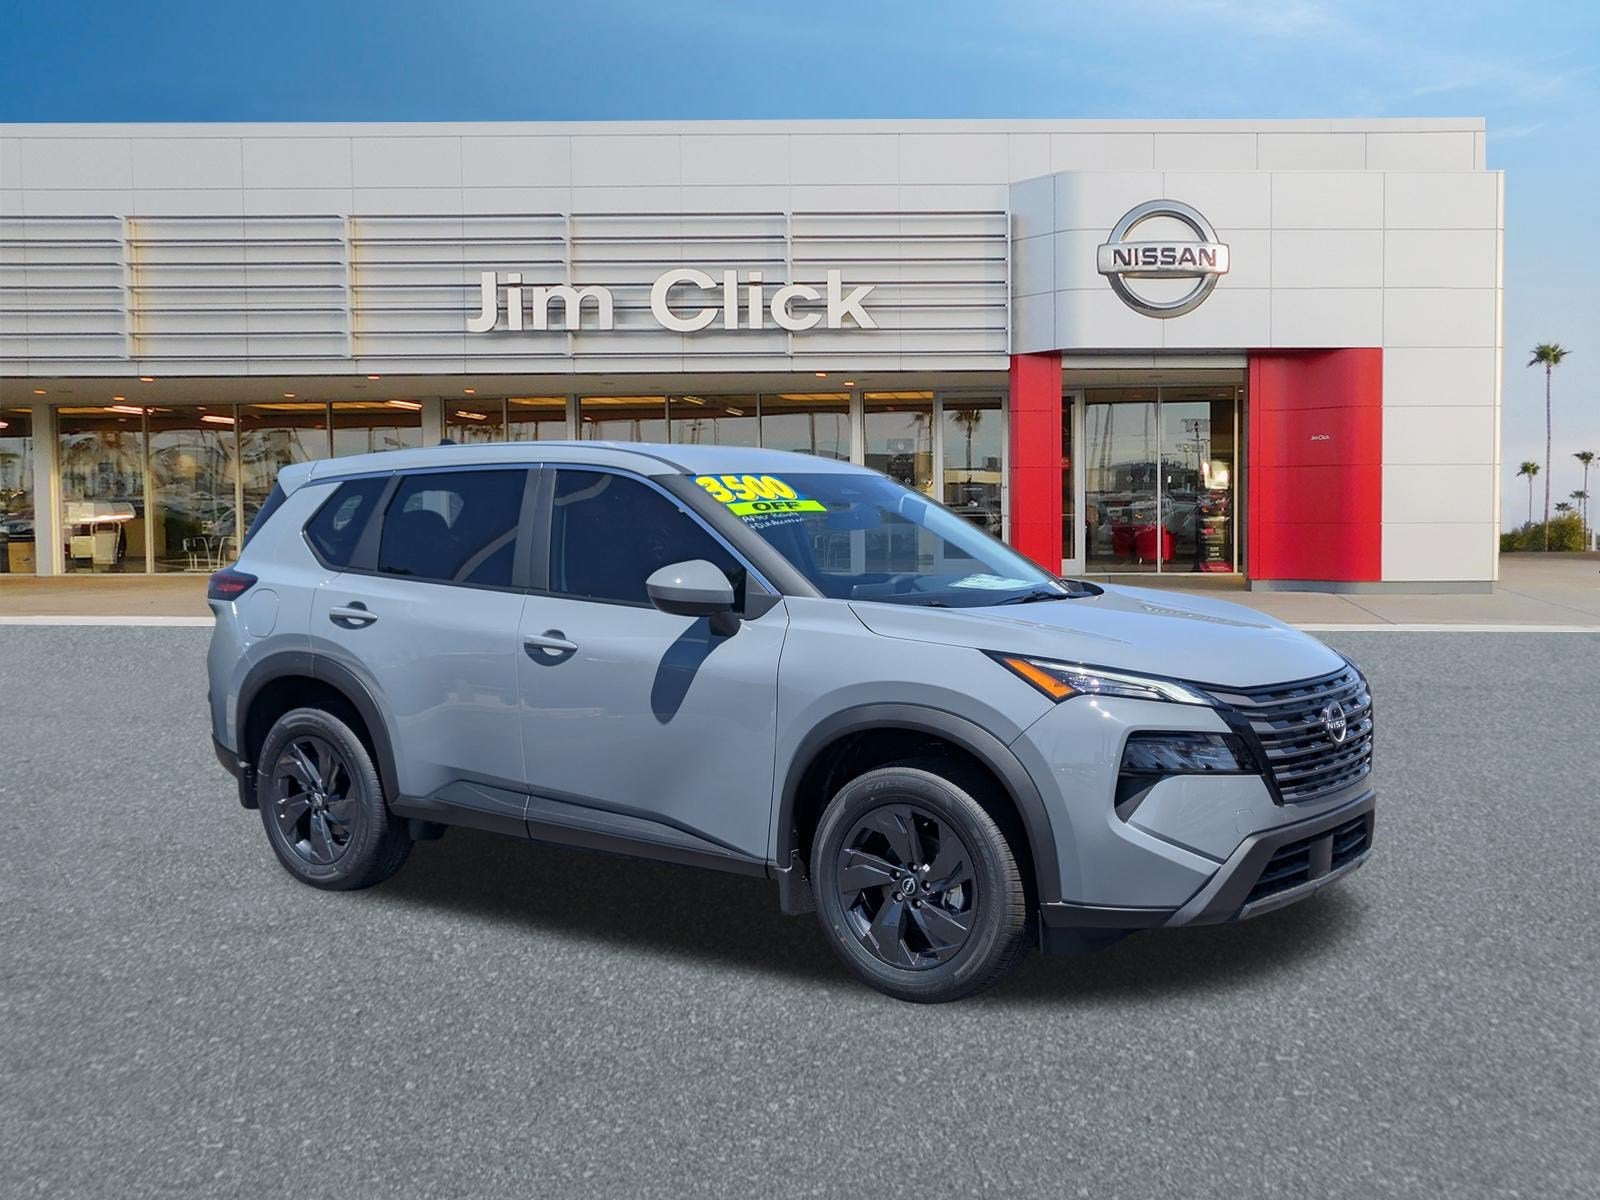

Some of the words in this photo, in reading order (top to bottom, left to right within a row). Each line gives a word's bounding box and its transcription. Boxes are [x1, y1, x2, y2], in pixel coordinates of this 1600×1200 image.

[1112, 247, 1217, 266] NISSAN
[467, 271, 613, 332] Jim
[650, 268, 879, 332] Click
[696, 475, 797, 502] 3500
[752, 502, 800, 511] OFF
